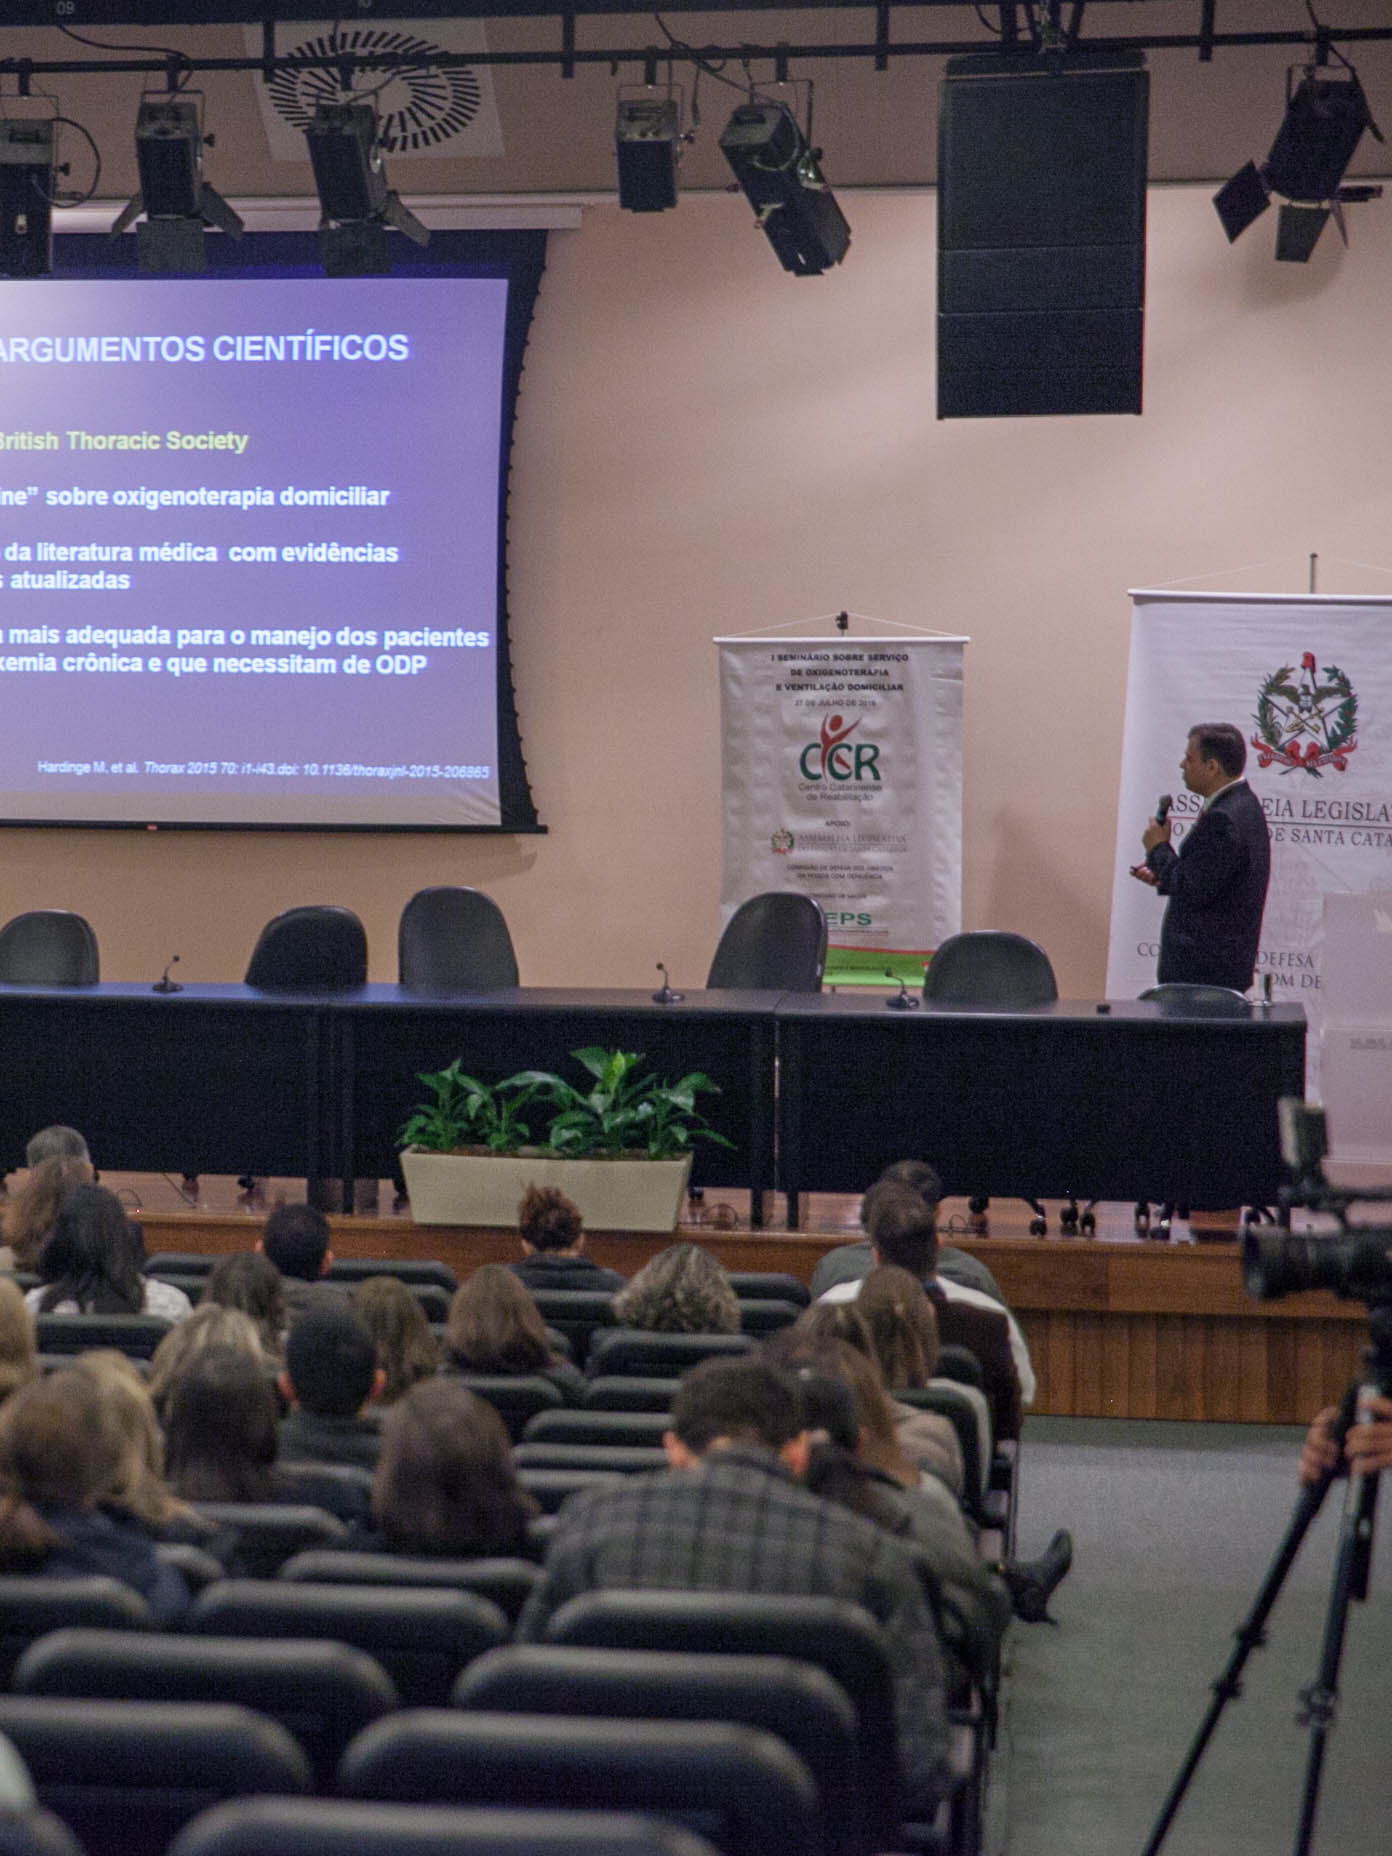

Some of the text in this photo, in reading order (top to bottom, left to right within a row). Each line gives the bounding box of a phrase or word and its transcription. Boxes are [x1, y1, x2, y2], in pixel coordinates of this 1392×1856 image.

[56, 1, 75, 15] 09
[214, 329, 409, 361] CIENTÍFICOS
[67, 431, 160, 449] Thoracic
[167, 431, 248, 454] Society
[47, 487, 109, 505] sobre
[113, 486, 275, 510] oxigenoterapia
[280, 486, 391, 505] domiciliar
[5, 543, 32, 561] da
[38, 543, 133, 561] literatura
[140, 542, 218, 561] médica
[229, 547, 277, 561] com
[282, 542, 399, 562] evidências
[11, 570, 130, 589] atualizadas
[9, 625, 60, 644] mais
[66, 625, 171, 649] adequada
[177, 630, 225, 649] para
[231, 630, 246, 645] o
[251, 626, 332, 650] manejo
[336, 627, 378, 646] dos
[384, 627, 490, 650] pacientes
[63, 652, 143, 672] crônica
[148, 657, 162, 672] e
[167, 657, 208, 676] que
[212, 654, 338, 674] necessitam
[343, 654, 371, 674] de
[375, 654, 428, 675] ODP
[833, 653, 865, 662] SOBRE
[868, 653, 909, 663] SERVIÇO
[790, 668, 889, 677] DE OXIGENOTERAPIA
[776, 682, 904, 692] E VENTILAÇÃO DOMICILIAR
[37, 760, 91, 776] Hardinge
[110, 761, 123, 774] et
[144, 761, 186, 774] Thorax
[187, 761, 218, 775] 2015
[1290, 829, 1345, 845] SANTA
